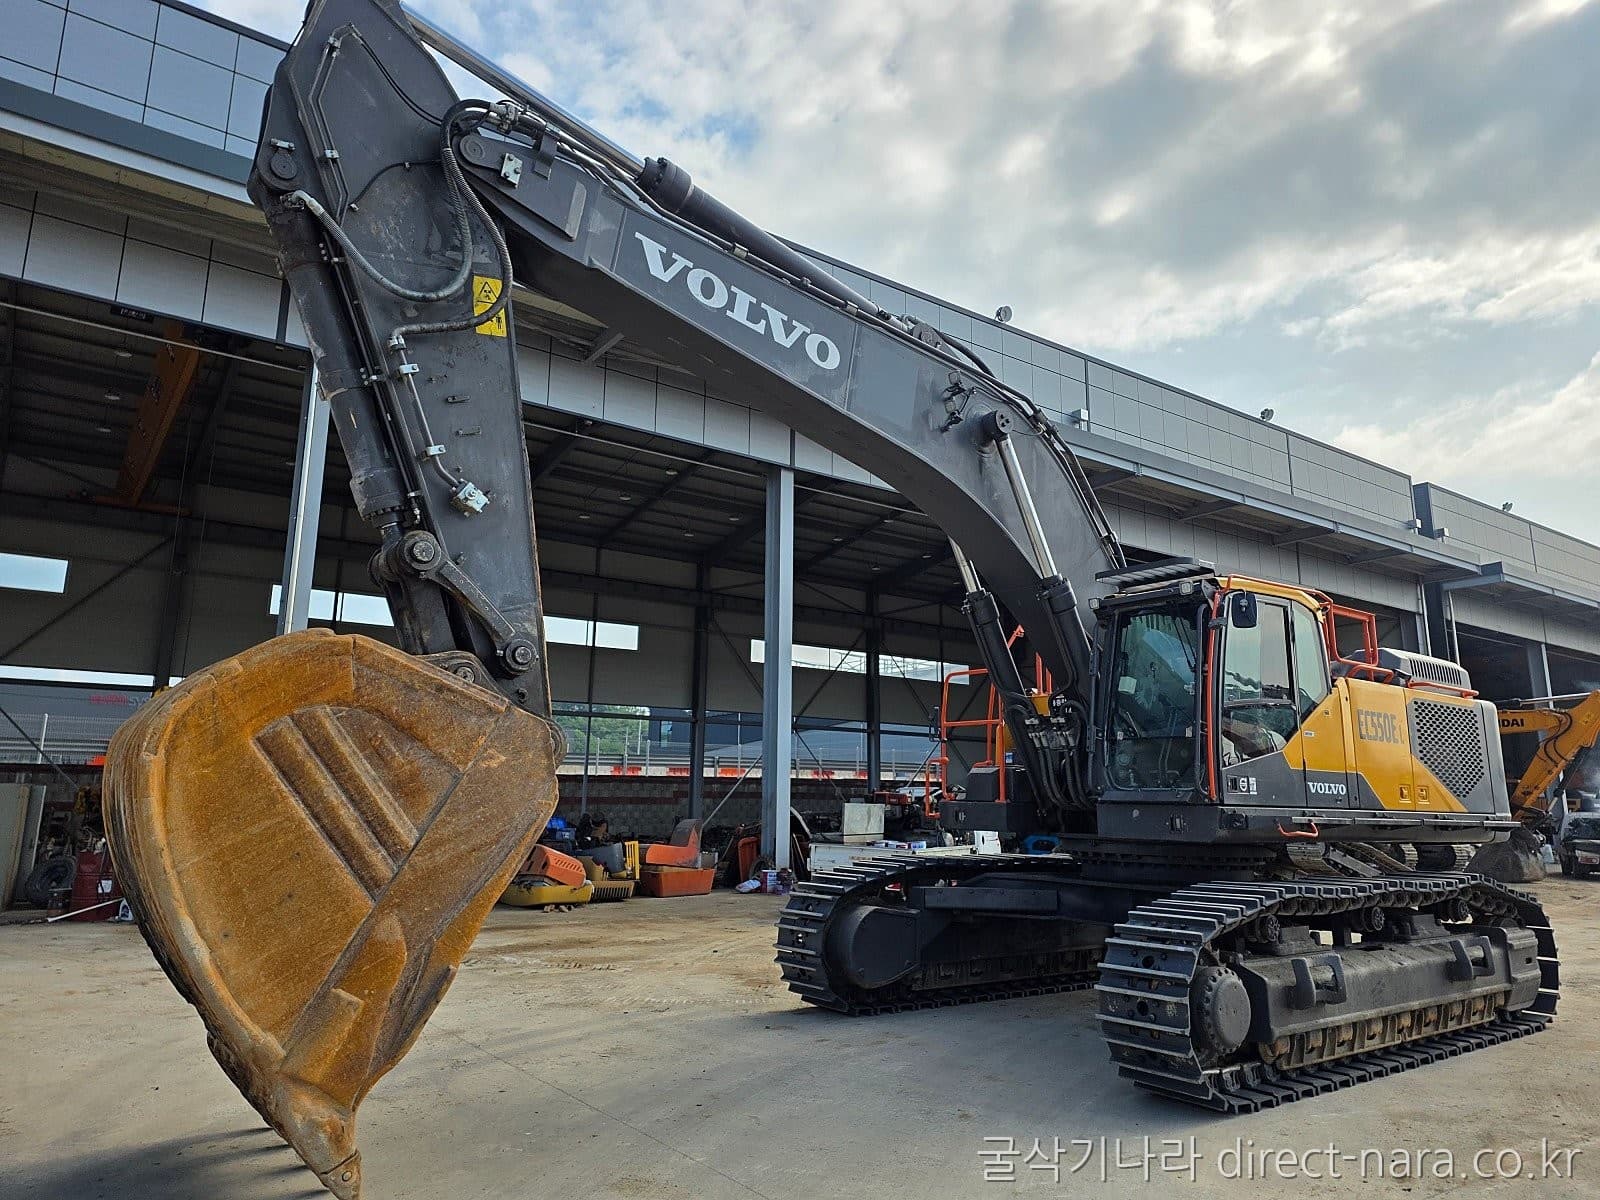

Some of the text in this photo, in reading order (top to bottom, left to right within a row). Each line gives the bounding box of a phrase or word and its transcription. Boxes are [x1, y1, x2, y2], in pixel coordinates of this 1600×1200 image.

[635, 231, 841, 370] VOLVO
[1499, 718, 1525, 728] DAI
[1307, 782, 1346, 795] VOLVO
